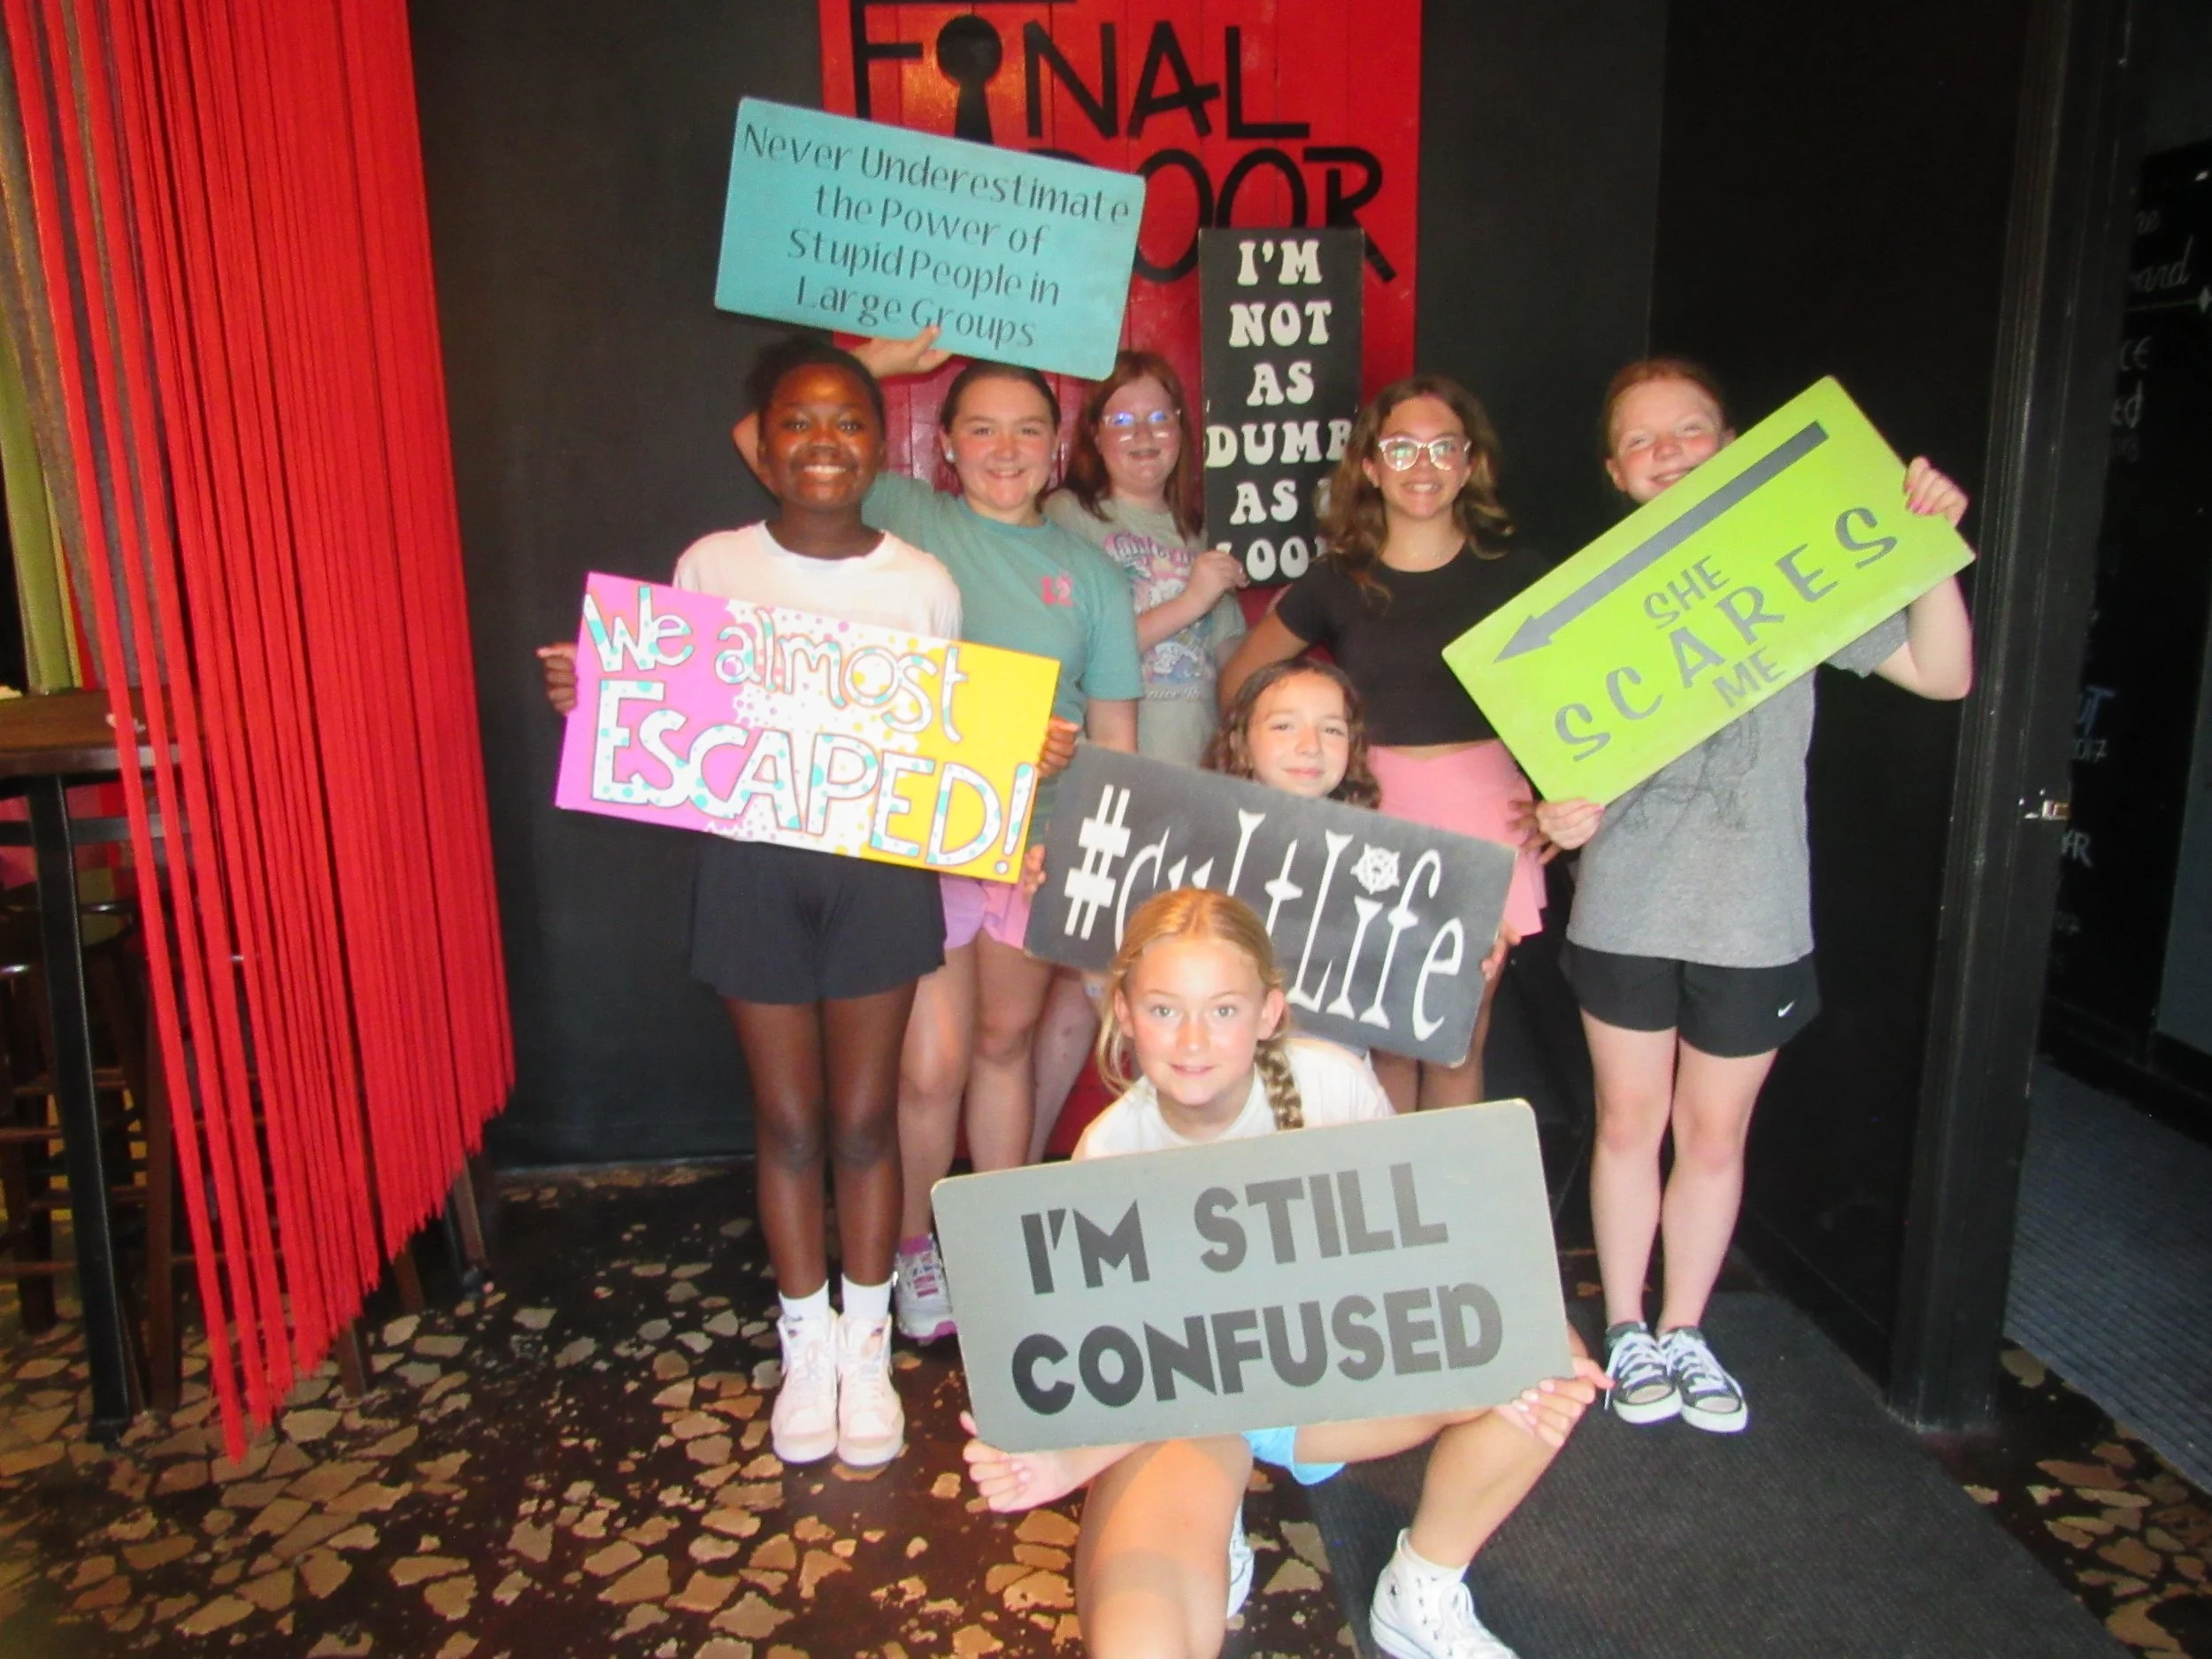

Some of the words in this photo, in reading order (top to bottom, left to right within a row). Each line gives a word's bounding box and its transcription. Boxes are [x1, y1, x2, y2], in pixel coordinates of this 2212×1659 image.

[743, 122, 854, 171] Never
[860, 145, 1130, 227] Underestimate
[815, 184, 873, 219] the
[879, 198, 1003, 248] Power
[1008, 224, 1048, 256] of
[1026, 146, 1396, 283] OOR
[787, 227, 904, 278] Stupid
[909, 250, 1023, 299] People
[1029, 271, 1060, 306] in
[1238, 239, 1323, 286] I'M
[796, 275, 903, 327] Large
[910, 298, 1036, 349] Groups
[1228, 300, 1333, 348] NOT
[1246, 360, 1315, 407] AS
[1204, 419, 1353, 468] DUMB
[1229, 480, 1299, 526] AS
[1216, 536, 1327, 581] OO
[1643, 555, 1730, 630] SHE
[584, 586, 695, 673] We
[714, 608, 969, 743] almost
[1554, 507, 1898, 762] SCARES
[1711, 647, 1786, 709] ME
[591, 678, 1037, 875] ESCAPED!
[1064, 784, 1465, 1041] #cltLife
[1021, 1199, 1151, 1295] I'M
[1194, 1162, 1449, 1273] STILL
[1011, 1282, 1504, 1416] CONFUSED
